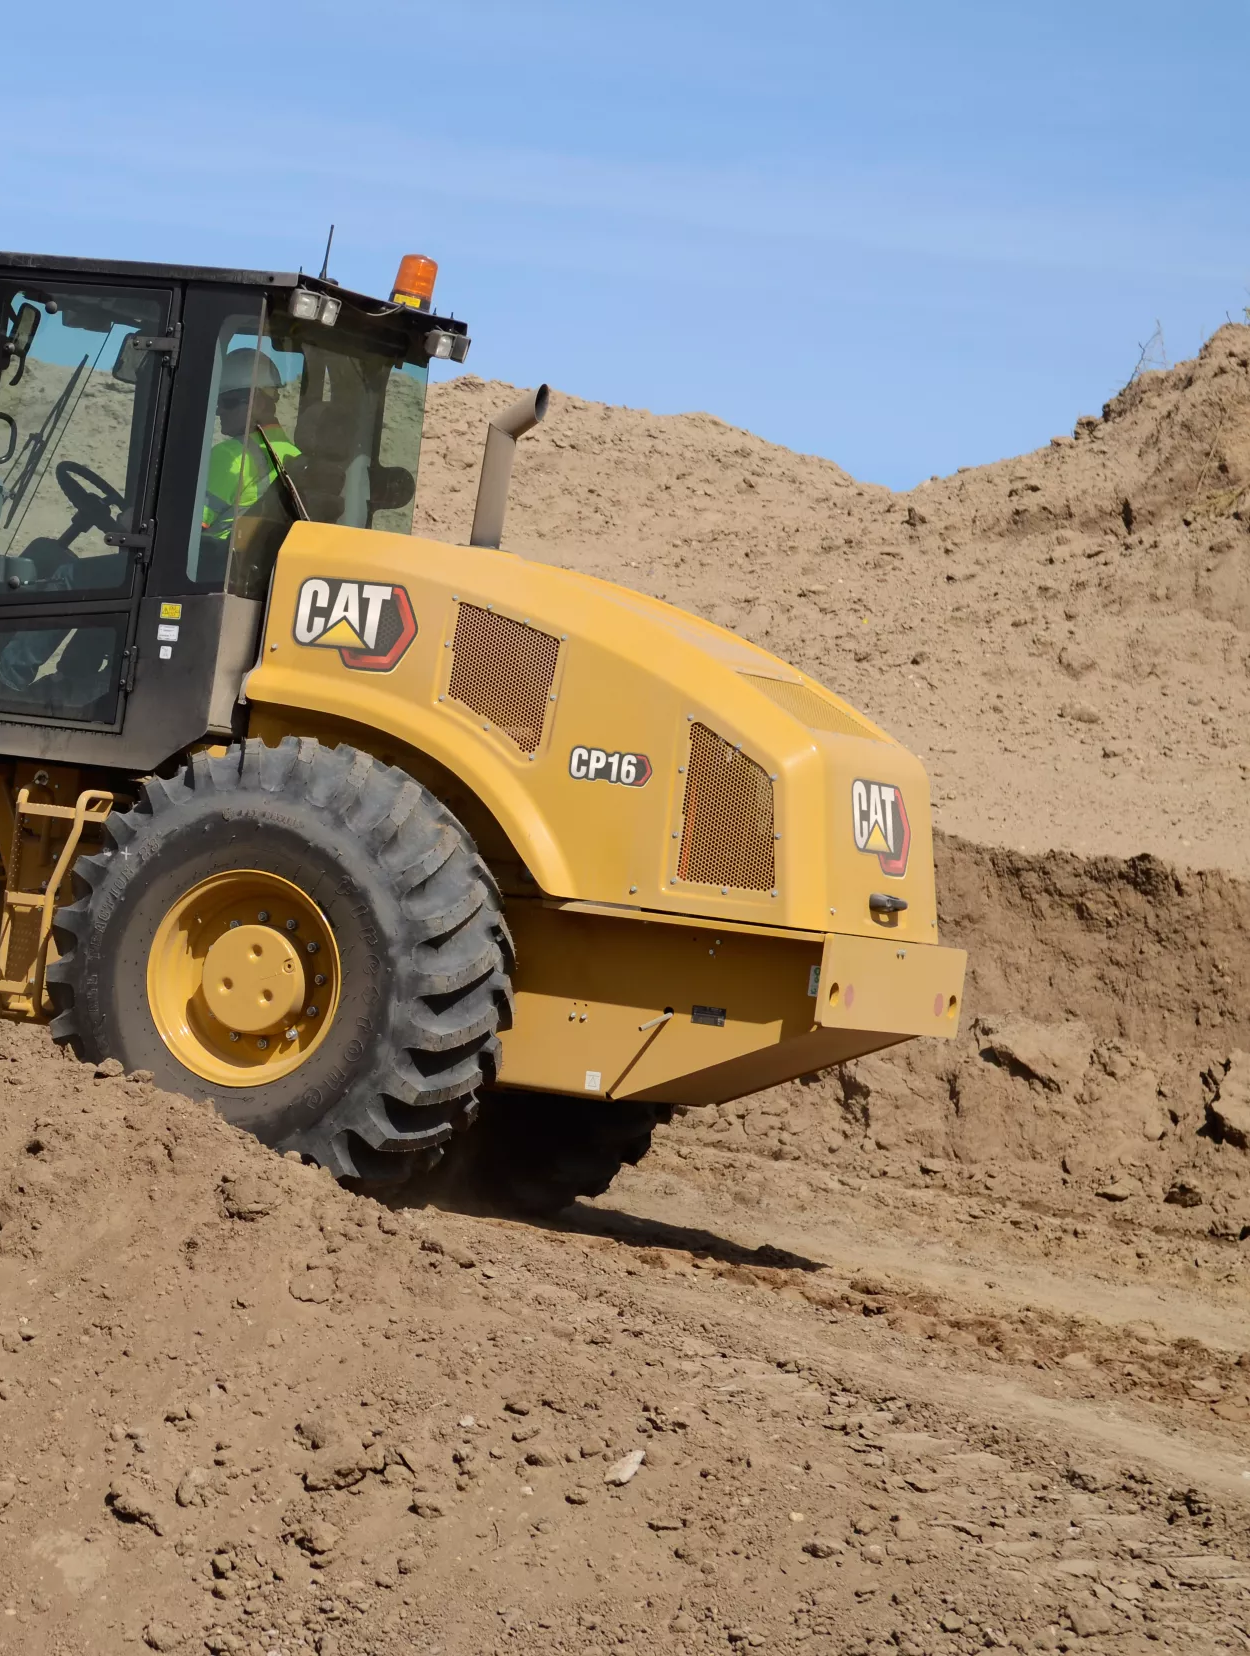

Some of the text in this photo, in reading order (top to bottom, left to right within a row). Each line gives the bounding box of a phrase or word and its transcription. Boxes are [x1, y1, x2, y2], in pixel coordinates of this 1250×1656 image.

[295, 579, 393, 649] CAT
[570, 747, 638, 784] CP16
[853, 781, 895, 853] CAT
[88, 864, 135, 961] TRACTION
